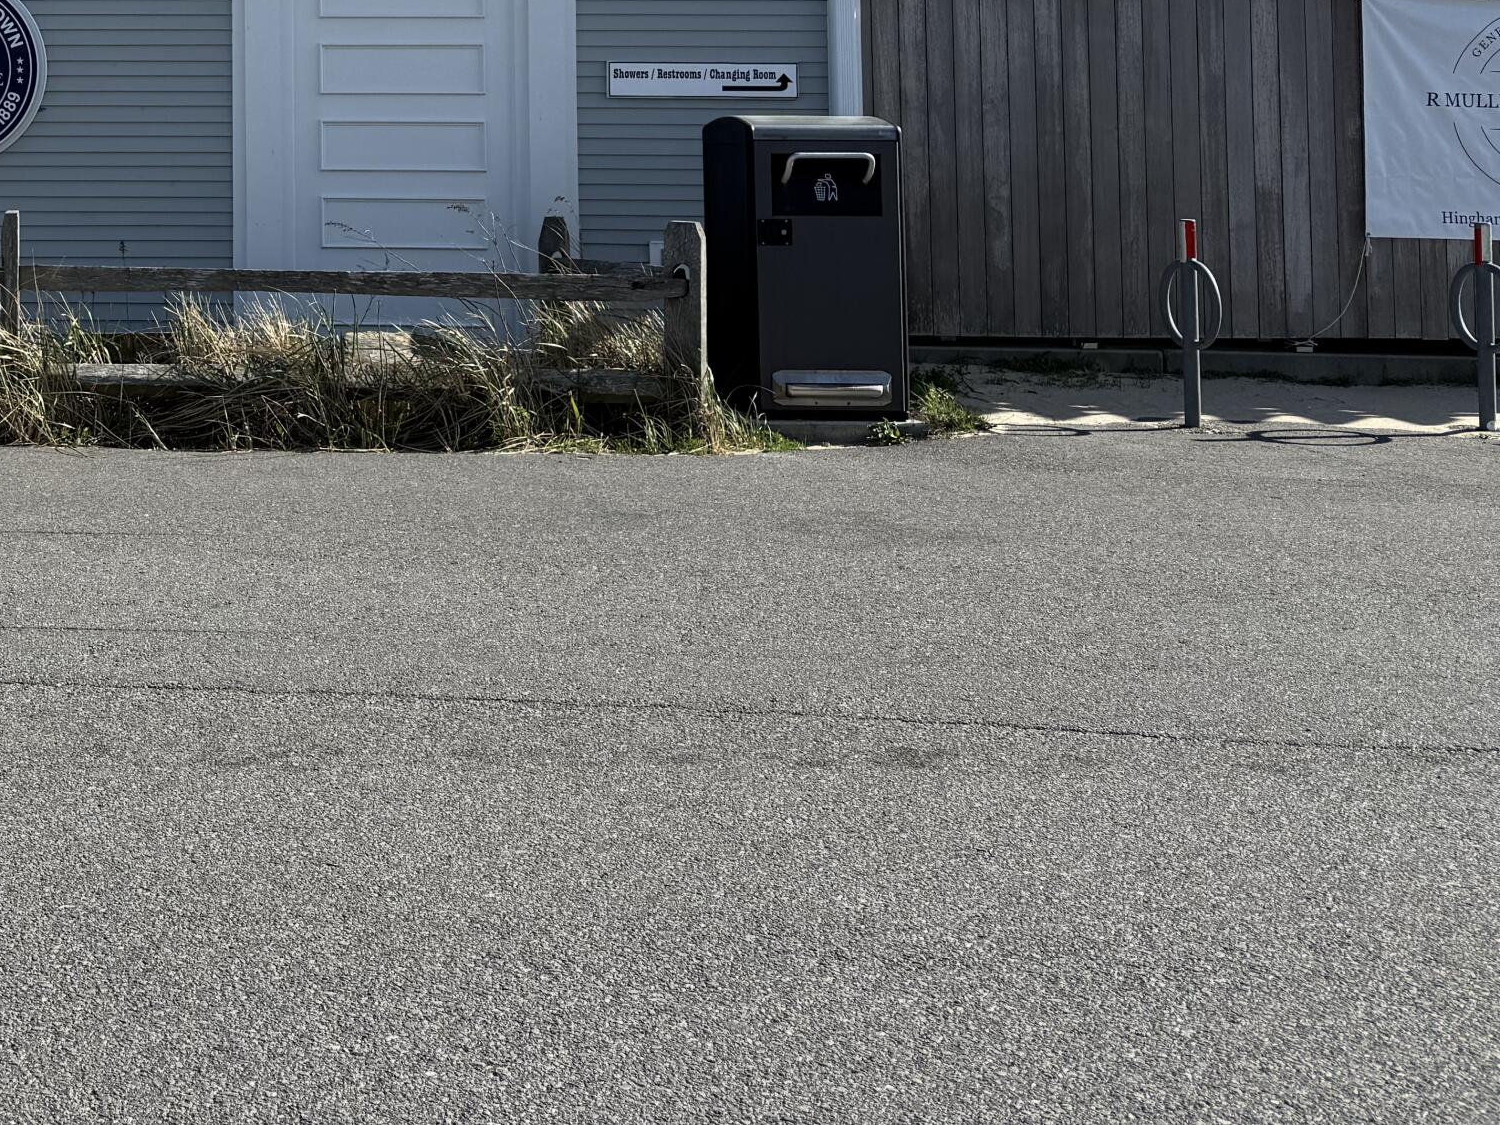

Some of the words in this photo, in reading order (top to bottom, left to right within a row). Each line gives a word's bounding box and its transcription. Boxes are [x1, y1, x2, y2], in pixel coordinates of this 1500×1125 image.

[613, 68, 649, 80] Showers
[657, 68, 702, 80] Restrooms
[709, 69, 751, 82] Changing
[752, 69, 777, 80] Room
[1425, 92, 1441, 107] R
[1444, 92, 1500, 109] MULL
